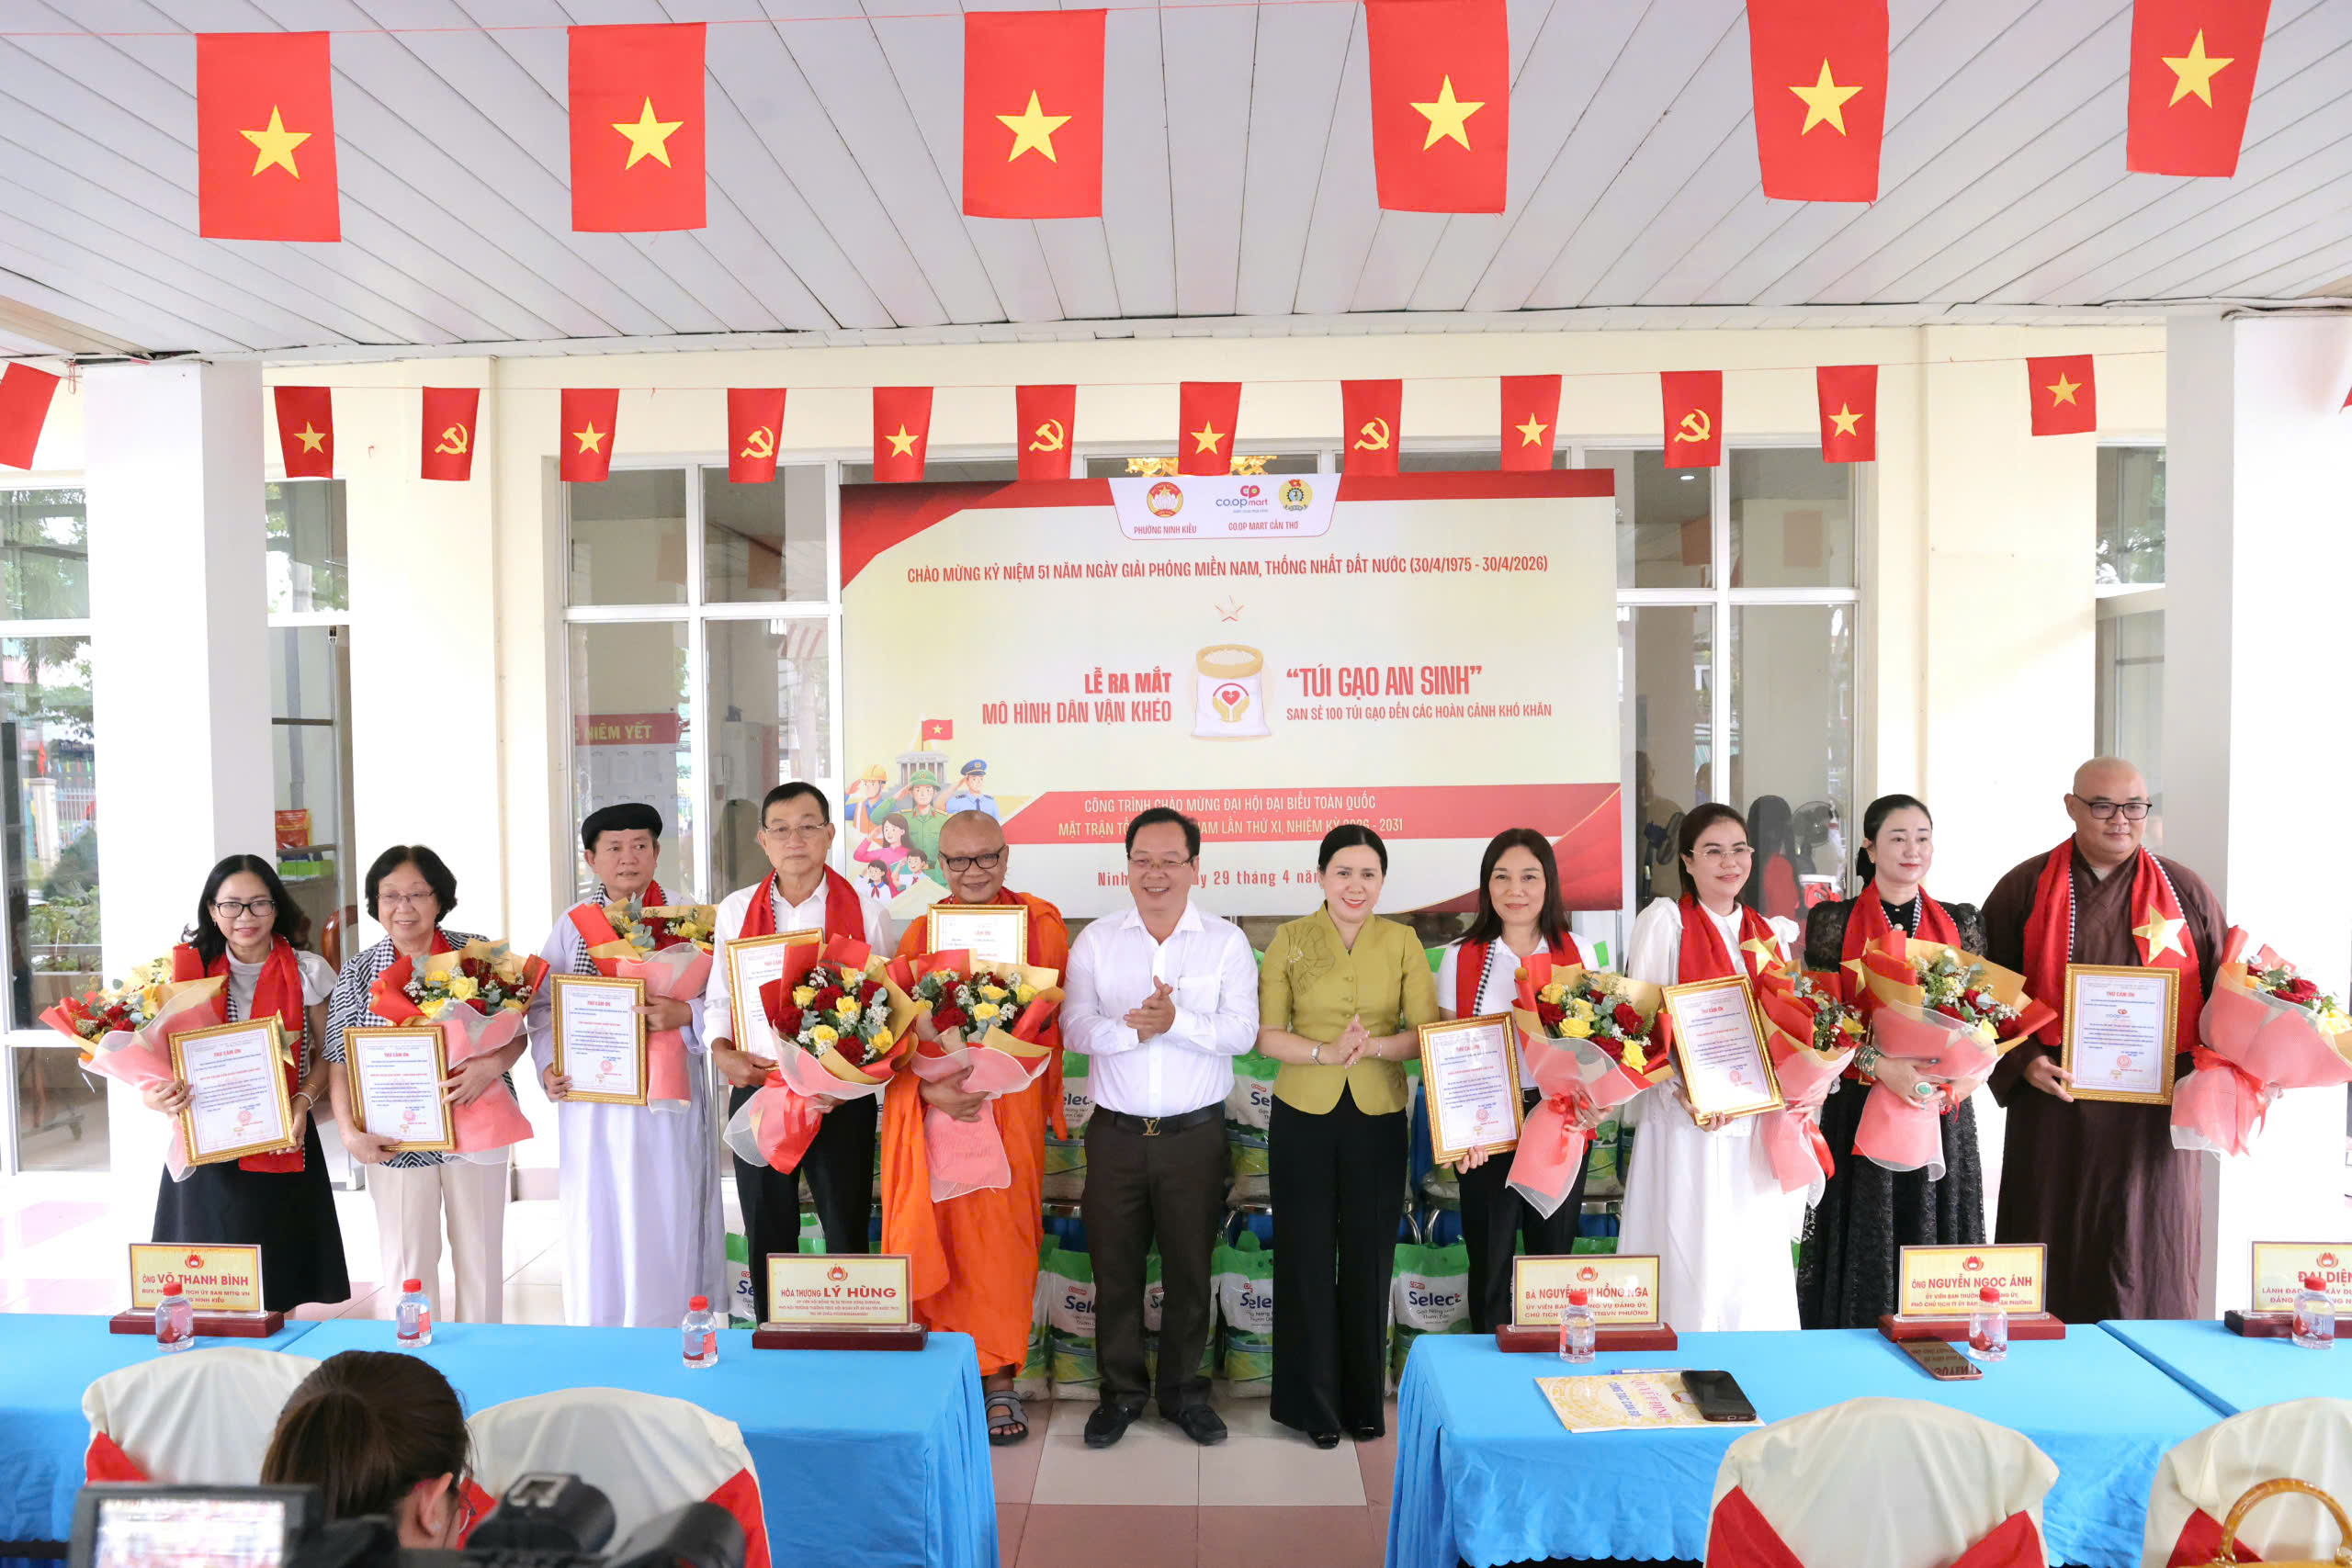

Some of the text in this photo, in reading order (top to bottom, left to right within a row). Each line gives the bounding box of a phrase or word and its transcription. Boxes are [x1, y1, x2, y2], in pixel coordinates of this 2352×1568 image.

[1163, 525, 1181, 535] NINH
[1228, 522, 1248, 531] CO.OP
[1249, 521, 1268, 530] MART
[908, 563, 939, 582] CHÀO
[943, 563, 980, 581] MỪNG
[1003, 563, 1035, 582] NIỆM
[1038, 565, 1050, 580] 51
[1054, 562, 1082, 580] NĂM
[1086, 560, 1118, 579] NGÀY
[1122, 559, 1145, 578] GIẢI
[1149, 559, 1192, 577] PHÓNG
[1194, 555, 1226, 577] MIỀN
[1230, 561, 1262, 578] NAM,
[1265, 554, 1306, 575] THỐNG
[1311, 553, 1343, 574] NHẤT
[1346, 553, 1369, 574] ĐẤT
[1373, 556, 1407, 573] NƯỚC
[1409, 557, 1471, 573] (30/4/1975
[1482, 555, 1548, 572] 30/4/2026)
[1085, 666, 1171, 694] LỄ RA MẮT
[1339, 667, 1379, 701] GẠO
[1385, 666, 1413, 696] AN
[982, 697, 1171, 725] MÔ HÌNH DÂN VẬN KHÉO
[1286, 707, 1308, 720] SAN
[1326, 706, 1343, 720] 100
[1346, 704, 1362, 719] TÚI
[1365, 706, 1385, 722] GẠO
[1388, 701, 1409, 719] ĐẾN
[1412, 703, 1432, 718] CÁC
[1435, 702, 1464, 718] HOÀN
[1467, 702, 1496, 718] CẢNH
[1498, 702, 1520, 717] KHÓ
[1523, 701, 1552, 716] KHĂN
[585, 722, 621, 740] NIÊM
[625, 720, 652, 739] YẾT
[1085, 796, 1115, 813] CÔNG
[1118, 796, 1151, 812] TRÌNH
[1185, 795, 1220, 812] MỪNG
[1223, 796, 1241, 814] ĐẠI
[1244, 795, 1263, 813] HỘI
[1266, 796, 1284, 813] ĐẠI
[1287, 790, 1311, 810] BIỂU
[1314, 793, 1342, 809] TOÀN
[1346, 790, 1376, 810] QUỐC
[1086, 819, 1114, 838] TRẬN
[1221, 816, 1244, 834] LẦN
[1247, 819, 1268, 834] THỨ
[1271, 820, 1284, 835] XI,
[1286, 817, 1323, 835] NHIỆM
[1379, 818, 1403, 831] 2031
[1098, 872, 1128, 887] Ninh
[1214, 871, 1230, 886] 29
[1237, 870, 1276, 887] tháng
[1283, 870, 1290, 884] 4
[178, 1274, 218, 1285] THANH
[220, 1273, 248, 1286] BÌNH
[1928, 1273, 1971, 1289] NGUYỄN
[2009, 1274, 2032, 1287] ÁNH
[823, 1285, 842, 1298] LÝ
[847, 1284, 897, 1298] HÙNG
[1409, 1291, 1462, 1306] Select
[1525, 1289, 1536, 1300] BÀ
[1597, 1282, 1624, 1298] HỒNG
